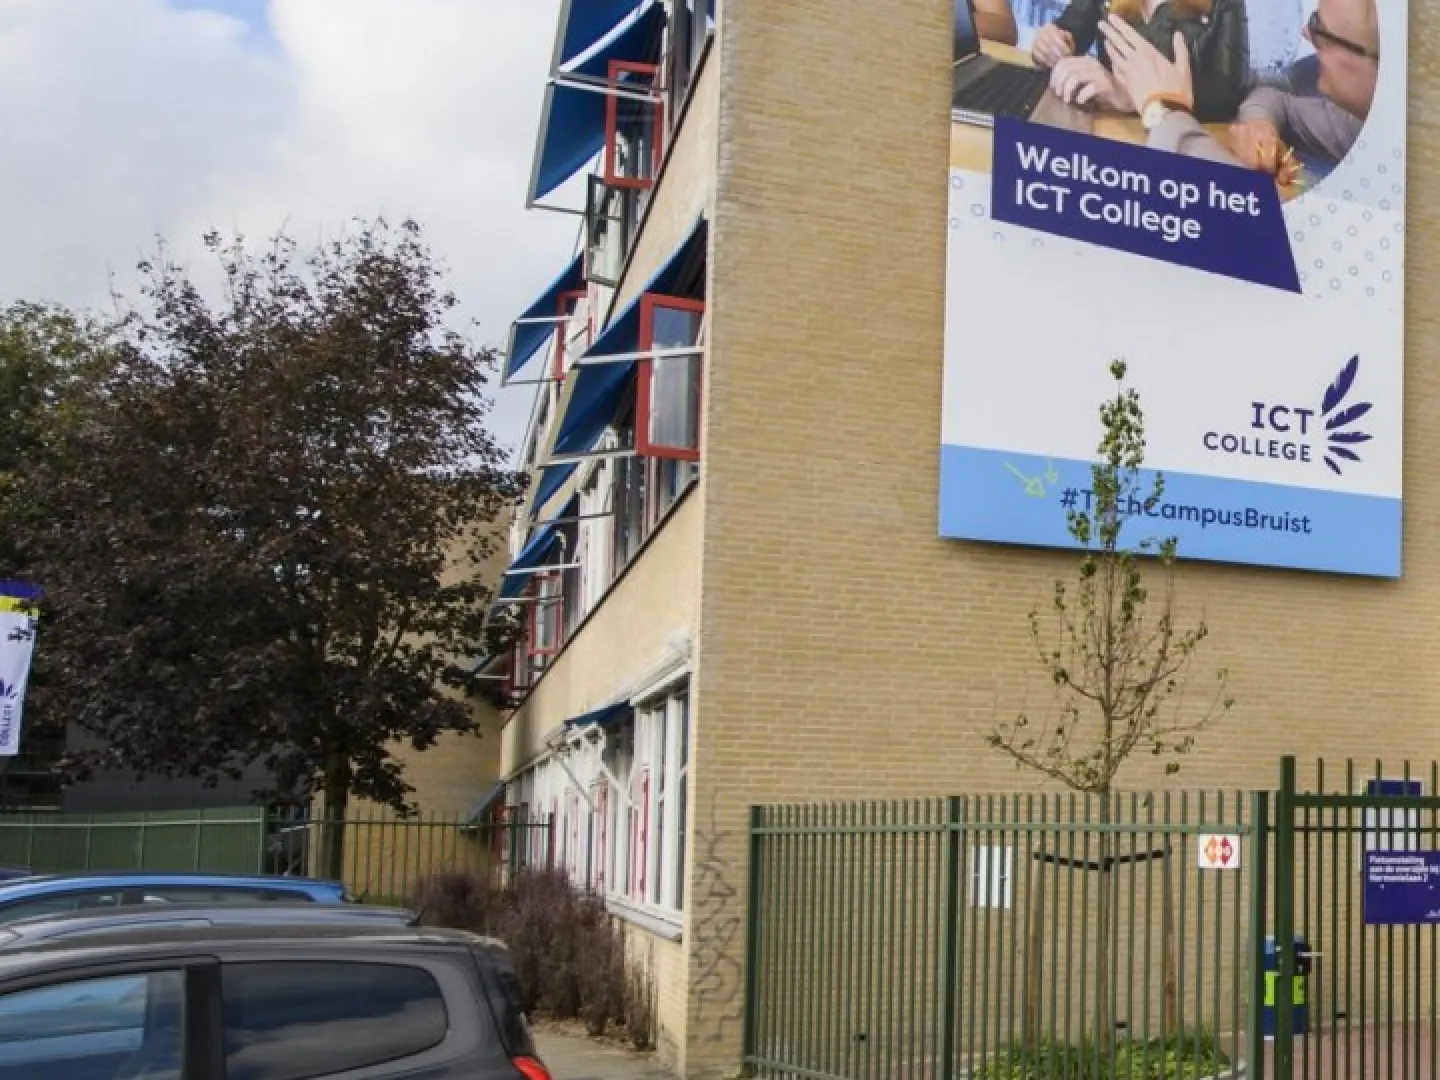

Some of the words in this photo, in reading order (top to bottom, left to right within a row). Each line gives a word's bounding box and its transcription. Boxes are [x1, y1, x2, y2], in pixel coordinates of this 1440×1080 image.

[1016, 141, 1150, 195] Welkom
[1159, 179, 1200, 209] op
[1208, 180, 1260, 217] het
[1016, 179, 1071, 214] ICT
[1079, 192, 1201, 242] College
[1251, 402, 1314, 434] ICT
[1203, 431, 1312, 462] COLLEGE
[1060, 487, 1312, 534] #TchCampusBruist
